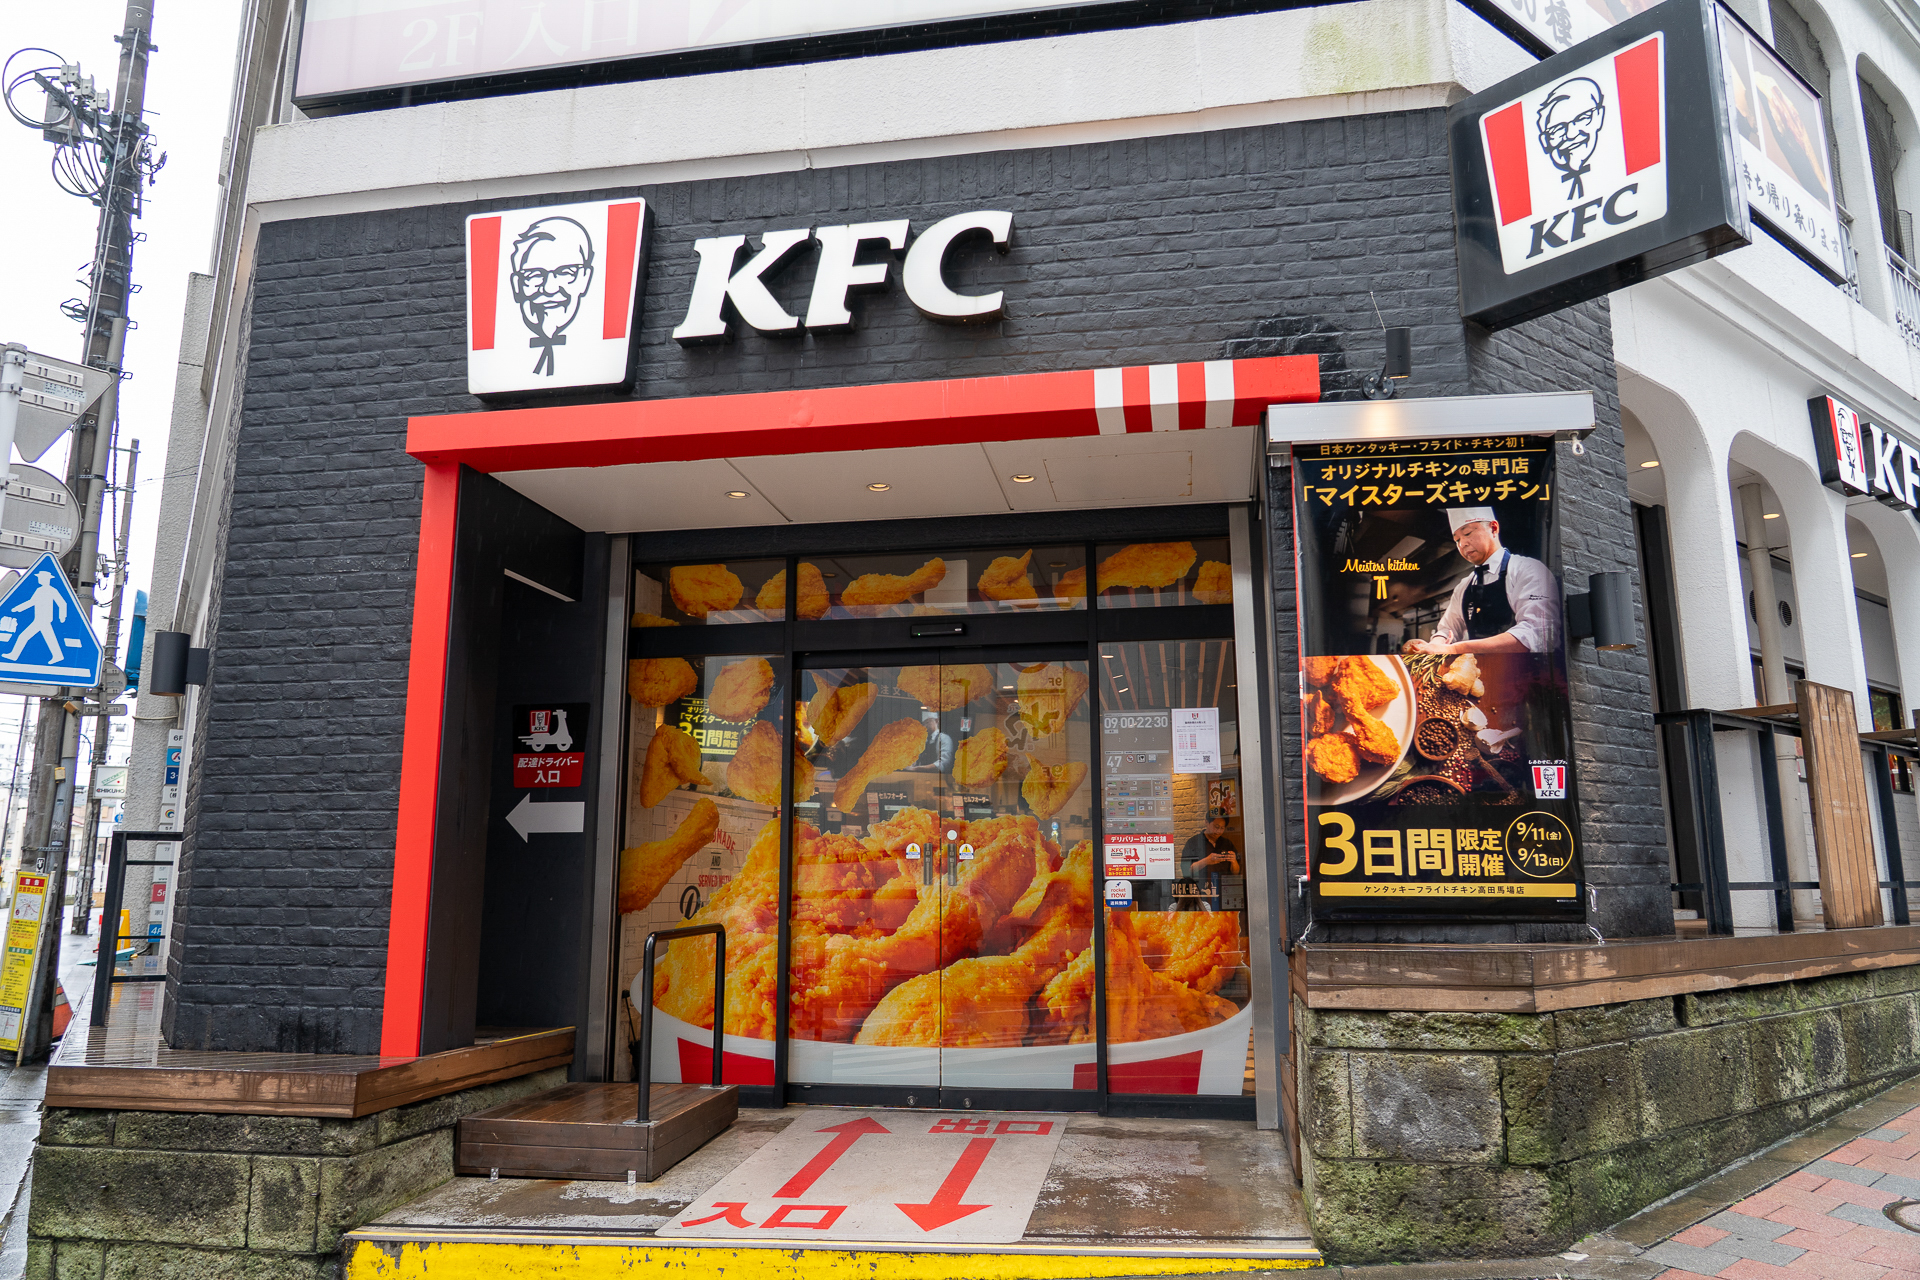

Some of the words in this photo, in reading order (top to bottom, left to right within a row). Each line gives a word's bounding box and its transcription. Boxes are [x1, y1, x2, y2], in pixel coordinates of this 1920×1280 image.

[398, 10, 484, 73] 2F
[1526, 183, 1639, 260] KFC
[672, 210, 1014, 341] KFC
[1320, 457, 1530, 481] オリジナルチキンの専門店
[1302, 479, 1551, 507] 「マイスターズキッチン」
[1340, 557, 1386, 573] Meisters
[1387, 557, 1421, 572] kitchen
[517, 756, 579, 769] 配達ドライバー
[1106, 755, 1122, 768] 47
[534, 770, 561, 784] 入口
[878, 792, 907, 800] セルフオーダー
[1540, 789, 1561, 797] KFC
[1110, 835, 1167, 843] デリバリー対応店舗
[1516, 822, 1562, 842] 9/11(金)
[1317, 811, 1454, 876] 3日間
[1456, 828, 1502, 851] 限定
[710, 855, 721, 867] AND
[1457, 853, 1506, 877] 開催
[1517, 847, 1564, 868] 9/13(日)
[698, 874, 718, 887] SERVED
[1363, 885, 1525, 895] ケンタッキーフライドチキン高田馬場店
[927, 1118, 1055, 1136] 出口
[680, 1201, 848, 1230] 入口
